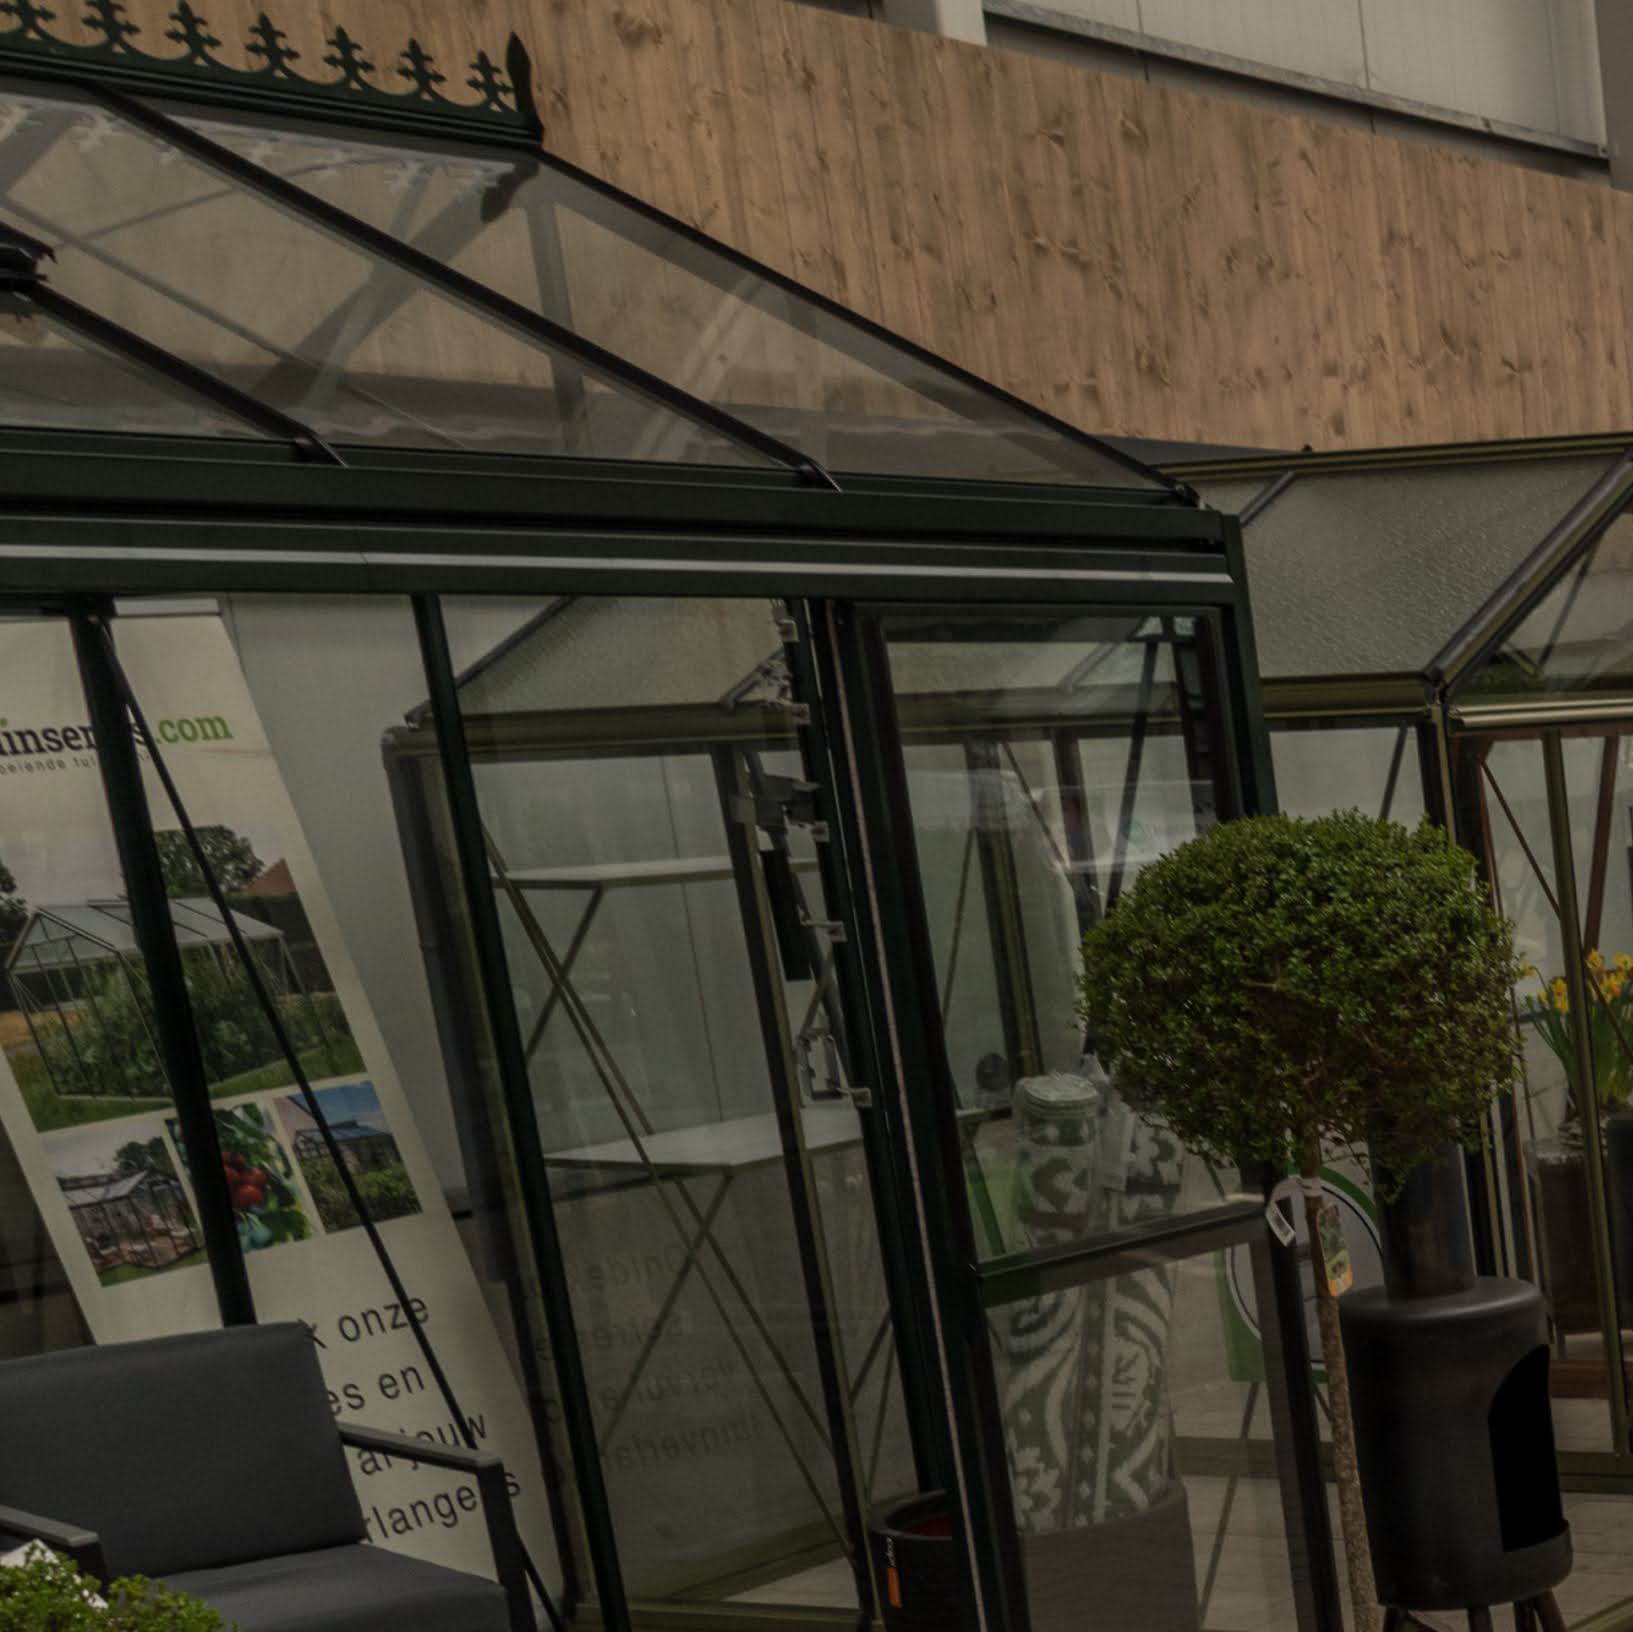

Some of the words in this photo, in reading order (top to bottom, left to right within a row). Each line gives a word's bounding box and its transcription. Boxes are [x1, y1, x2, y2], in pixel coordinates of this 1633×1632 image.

[338, 1296, 430, 1343] onze
[379, 1364, 426, 1402] en
[363, 1471, 522, 1544] rlanges
